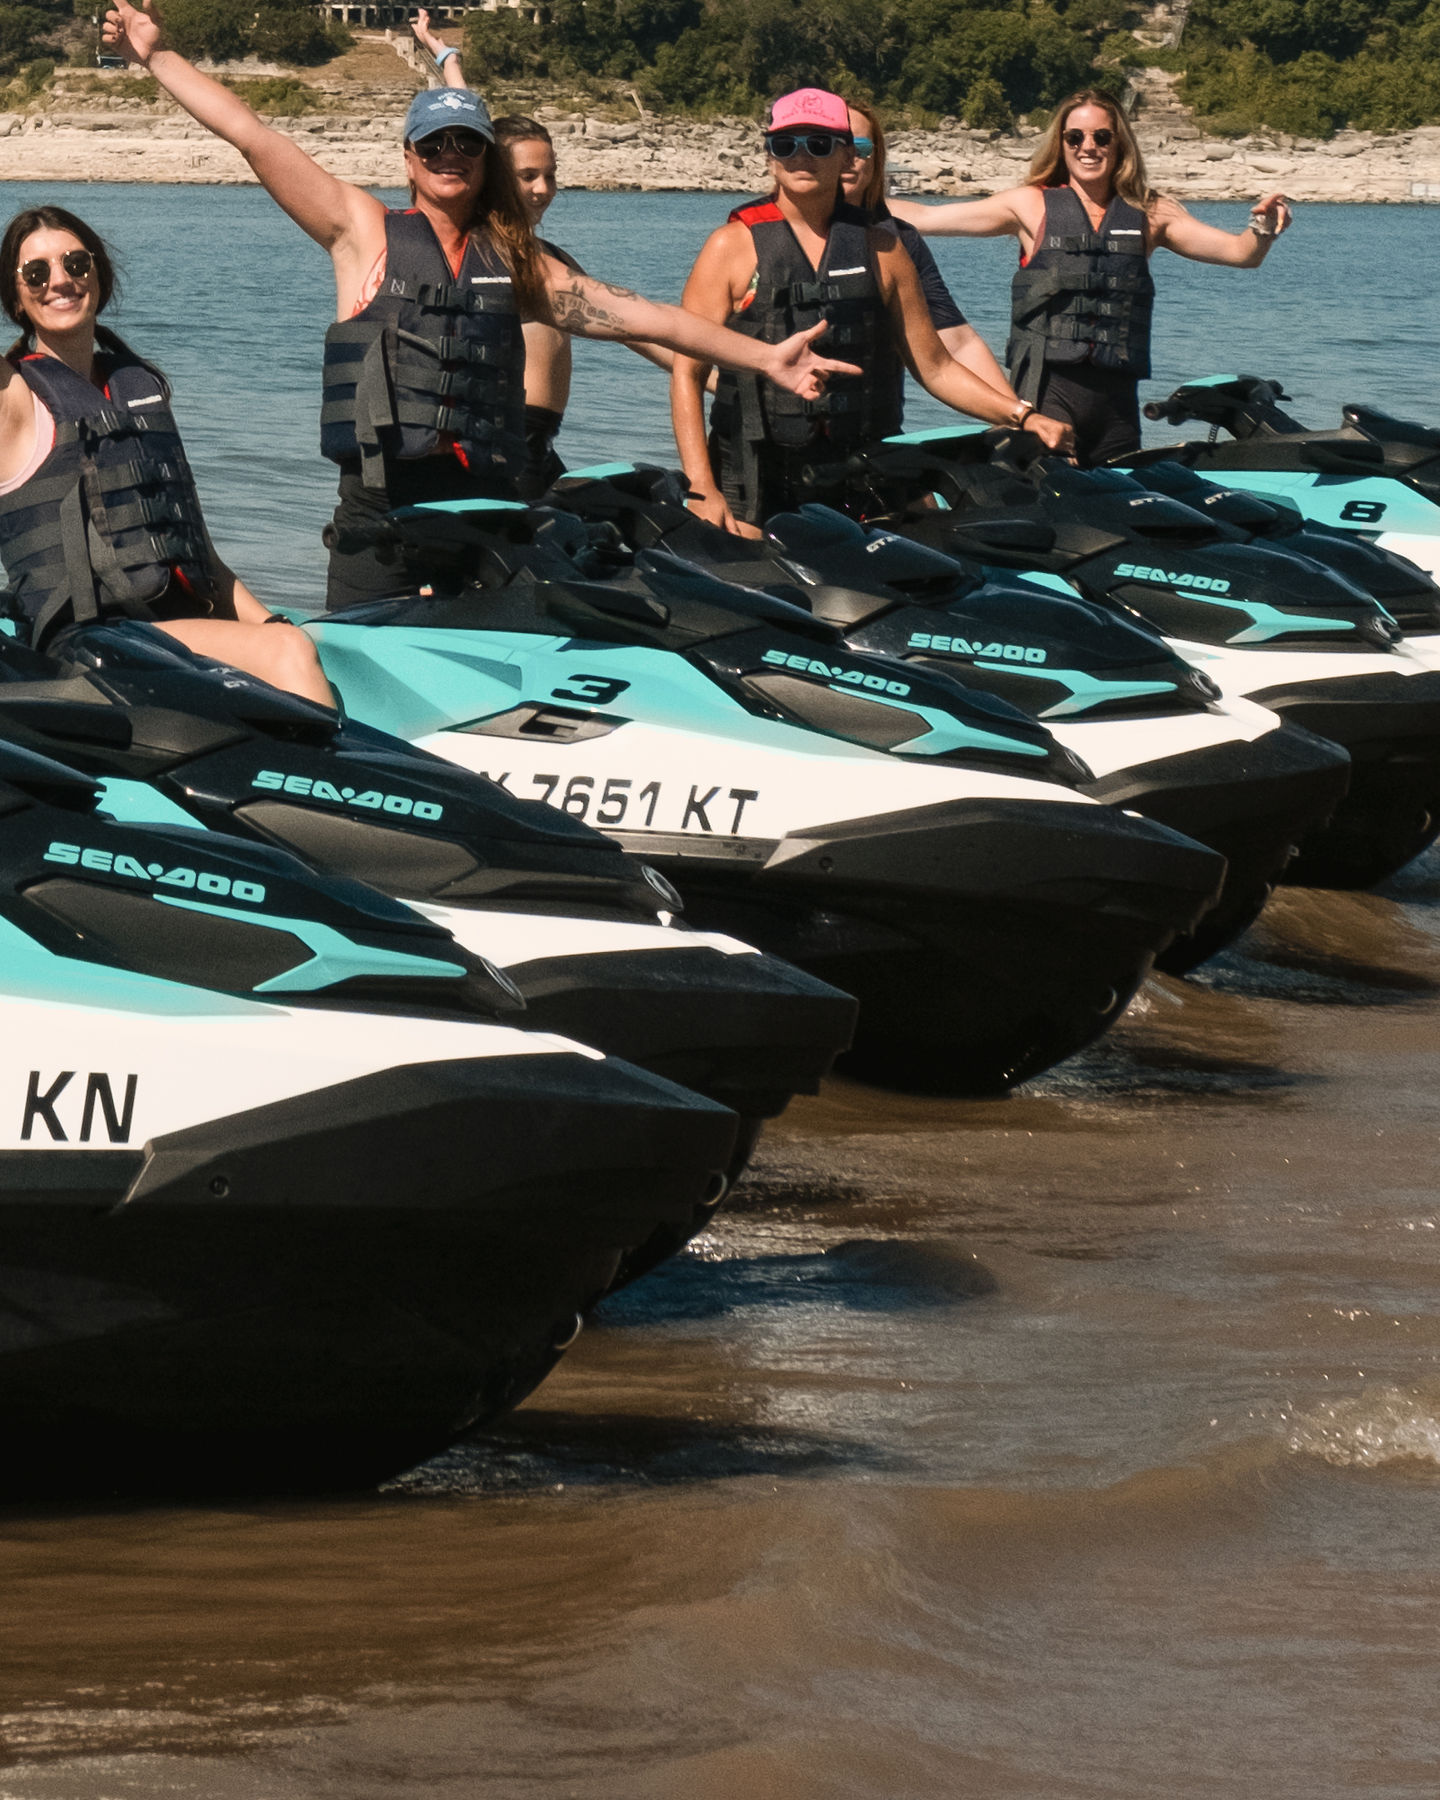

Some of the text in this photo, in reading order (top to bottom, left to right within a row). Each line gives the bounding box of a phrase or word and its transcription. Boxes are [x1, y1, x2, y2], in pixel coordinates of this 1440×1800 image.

[1340, 500, 1387, 523] 8
[550, 674, 632, 705] 3
[532, 773, 661, 827] 7651
[681, 785, 759, 835] KT
[20, 1070, 138, 1144] KN
